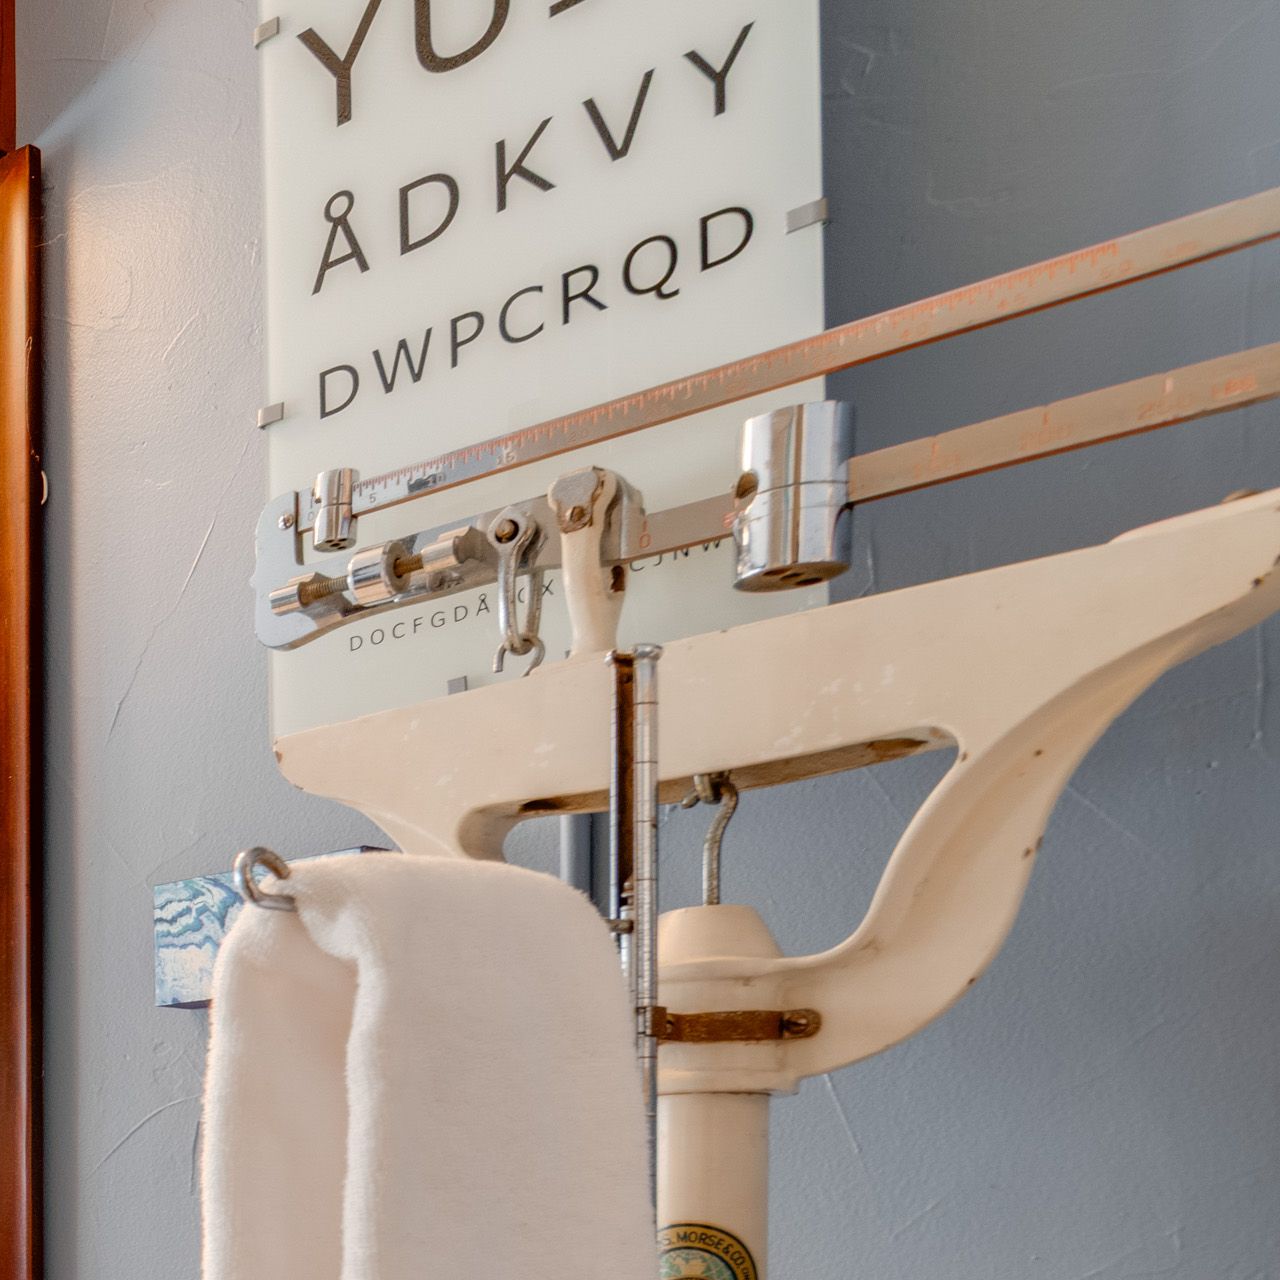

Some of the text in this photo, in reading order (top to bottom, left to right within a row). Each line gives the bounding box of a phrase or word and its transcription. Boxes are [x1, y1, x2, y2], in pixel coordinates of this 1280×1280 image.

[297, 0, 587, 127] YU
[311, 21, 755, 296] ÅDKVY
[319, 206, 755, 420] DWPCRQD
[368, 492, 377, 503] 5
[495, 450, 517, 465] 15
[639, 532, 652, 549] 0
[350, 592, 491, 652] DOCFGDÅ
[676, 1230, 725, 1250] MORSE
